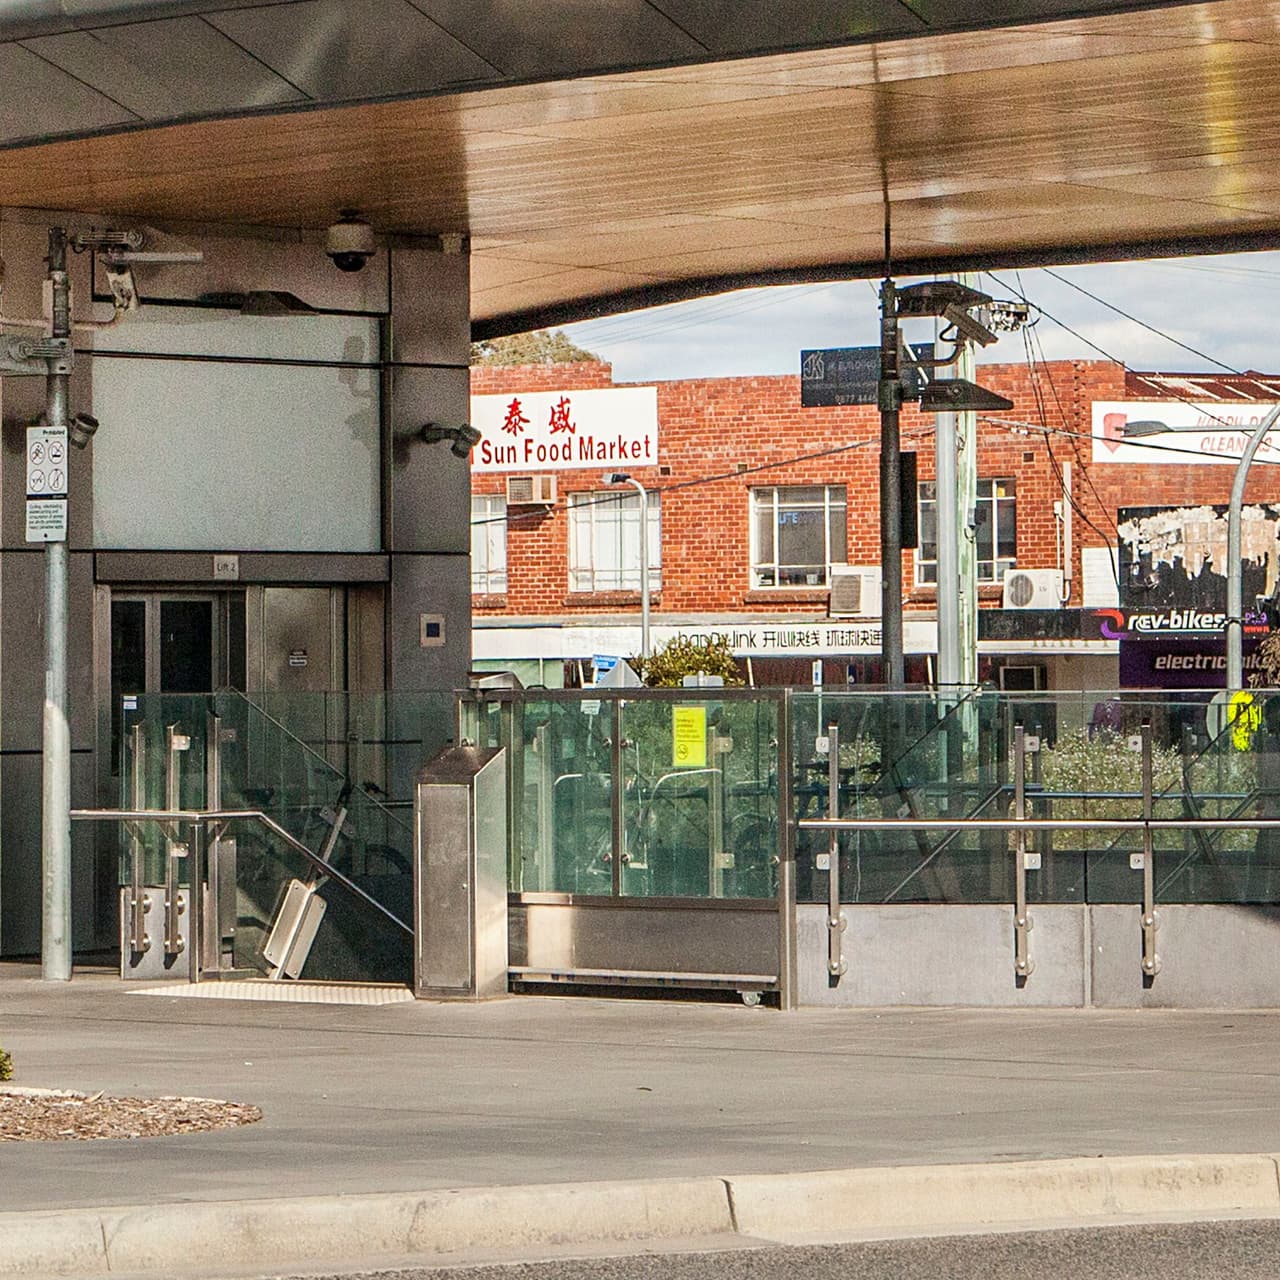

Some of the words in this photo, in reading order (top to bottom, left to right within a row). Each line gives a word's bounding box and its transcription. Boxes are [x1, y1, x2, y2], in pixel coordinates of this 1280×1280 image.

[501, 395, 576, 437] 泰盛
[481, 439, 517, 465] Sun
[524, 437, 572, 463] Food
[579, 434, 651, 461] Market
[1200, 436, 1273, 453] CLEANS
[216, 562, 228, 572] Lift
[230, 562, 236, 572] 2
[1155, 654, 1228, 670] electric
